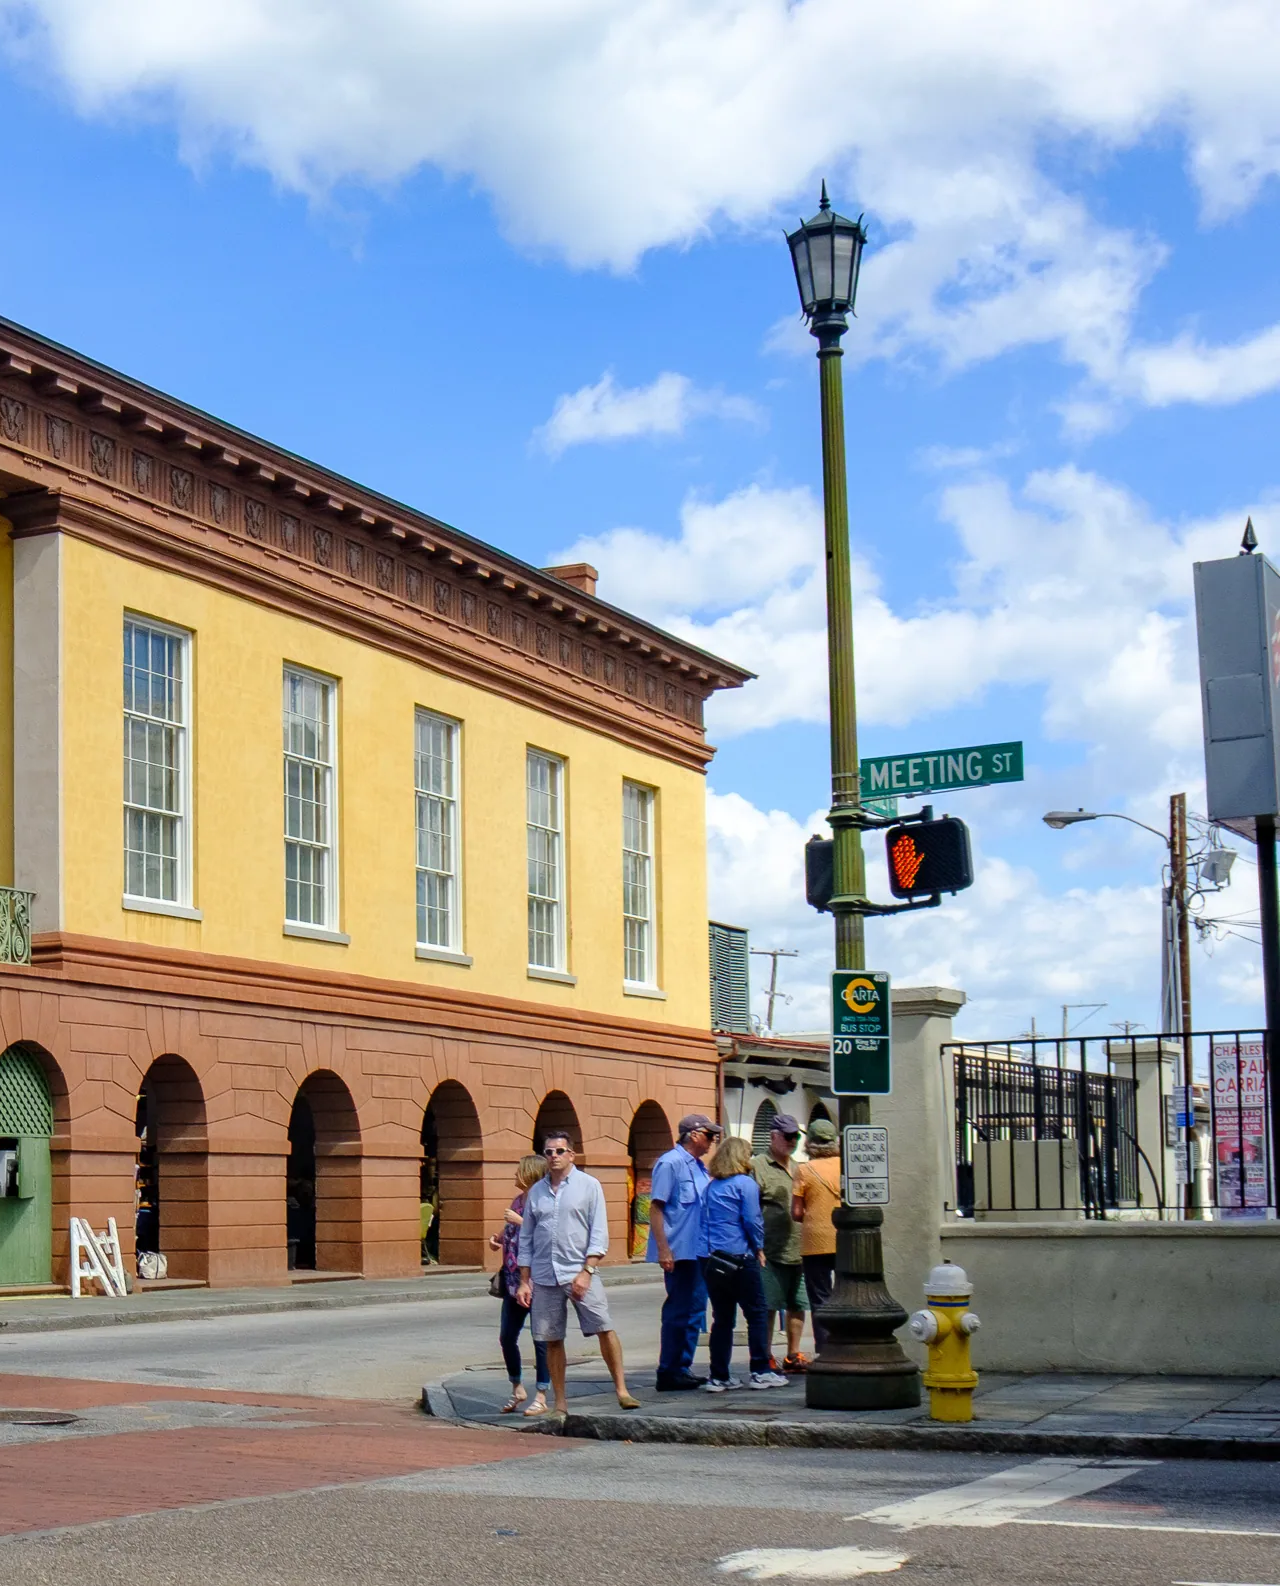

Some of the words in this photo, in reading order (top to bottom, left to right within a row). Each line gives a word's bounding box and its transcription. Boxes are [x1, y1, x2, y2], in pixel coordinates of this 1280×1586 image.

[870, 751, 983, 791] MEETING
[992, 752, 1013, 773] ST
[841, 989, 880, 1001] CARTA
[840, 1023, 857, 1032] BUS
[859, 1024, 881, 1032] STOP
[834, 1039, 852, 1054] 20
[1214, 1045, 1265, 1057] CHARLEST
[1215, 1077, 1265, 1093] CARRIA
[1216, 1094, 1264, 1104] TICETS
[872, 1133, 885, 1141] BUS
[850, 1143, 876, 1152] LOADING
[850, 1153, 885, 1163] UNLOADING
[859, 1164, 875, 1174] ONLY
[852, 1182, 863, 1191] TEN
[865, 1182, 886, 1191] MINUTE
[855, 1191, 868, 1200] TIME
[868, 1191, 883, 1200] LIMIT
